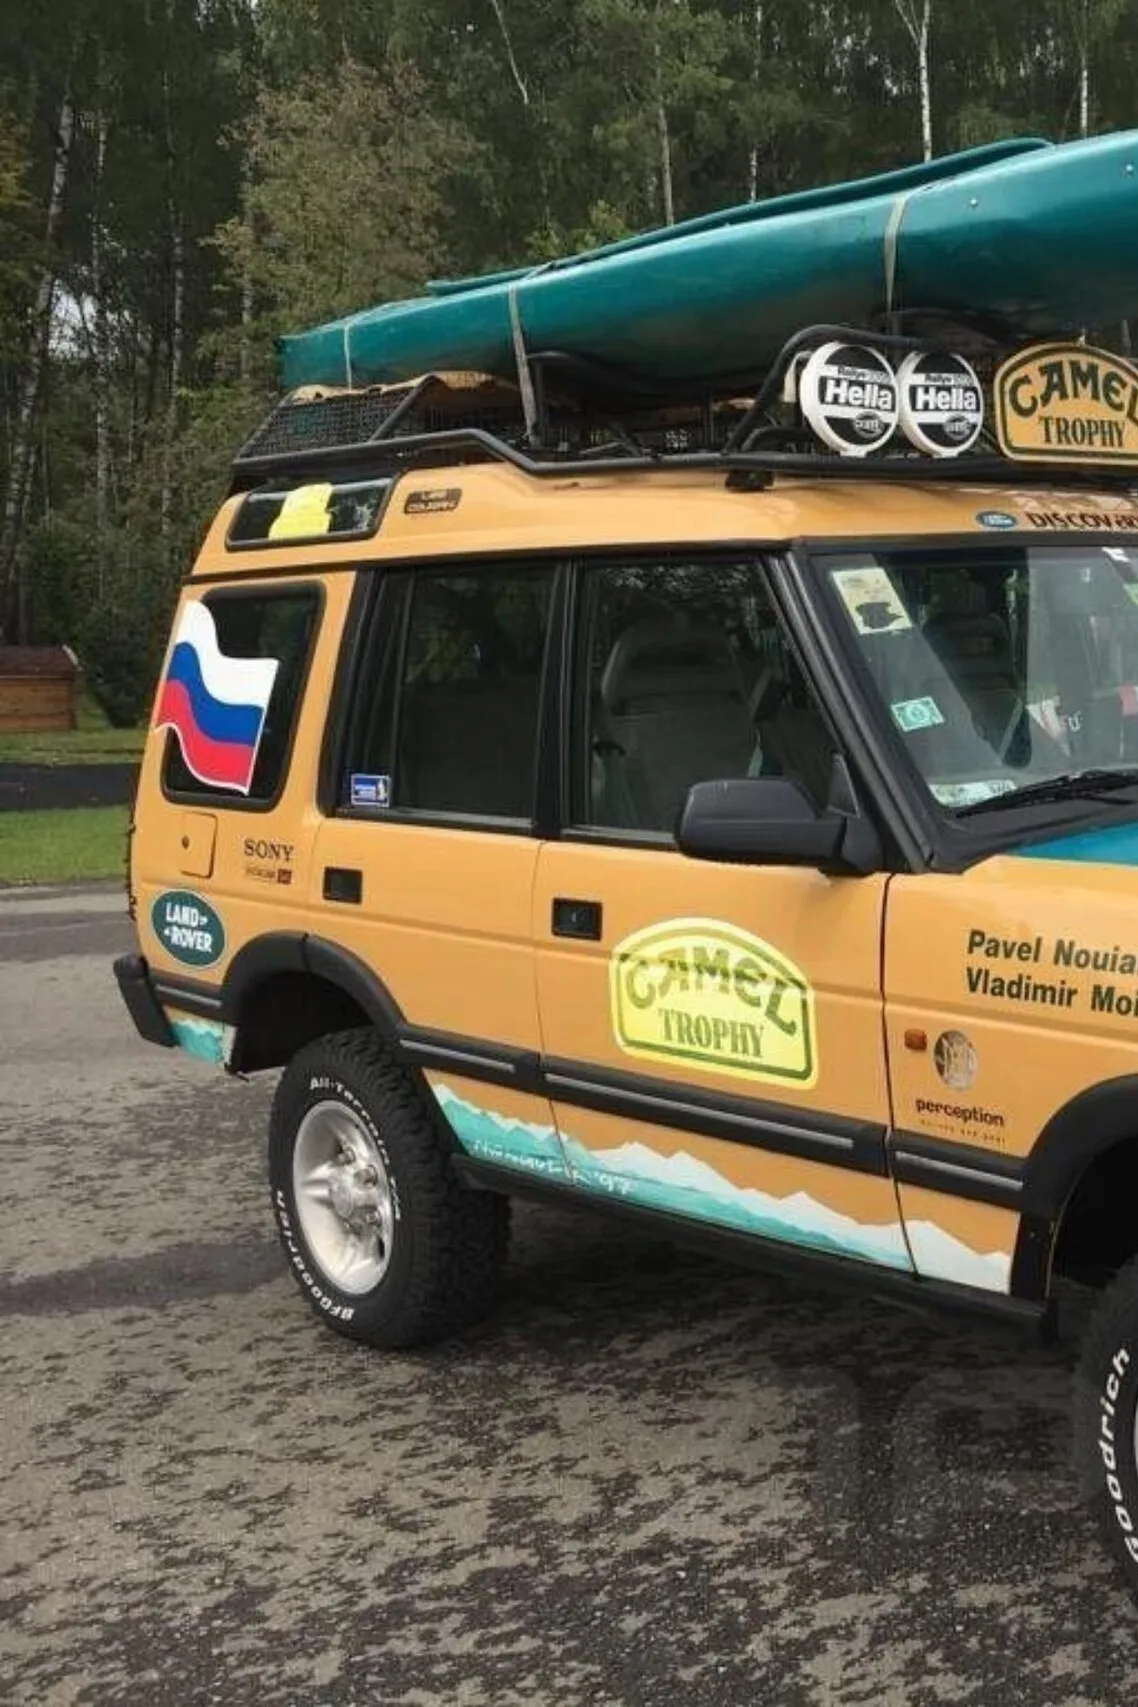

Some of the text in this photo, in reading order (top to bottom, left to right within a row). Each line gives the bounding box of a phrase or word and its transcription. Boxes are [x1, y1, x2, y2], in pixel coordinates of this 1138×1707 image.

[823, 378, 893, 411] Hella
[915, 386, 977, 411] Hella
[1037, 415, 1126, 448] TROPHY
[243, 838, 294, 862] SONY
[967, 928, 1043, 963] Pavel
[626, 945, 797, 1036] CAMEL
[966, 966, 1078, 1008] Vladimir
[658, 1008, 765, 1058] TROPHY
[915, 1098, 1005, 1127] perception
